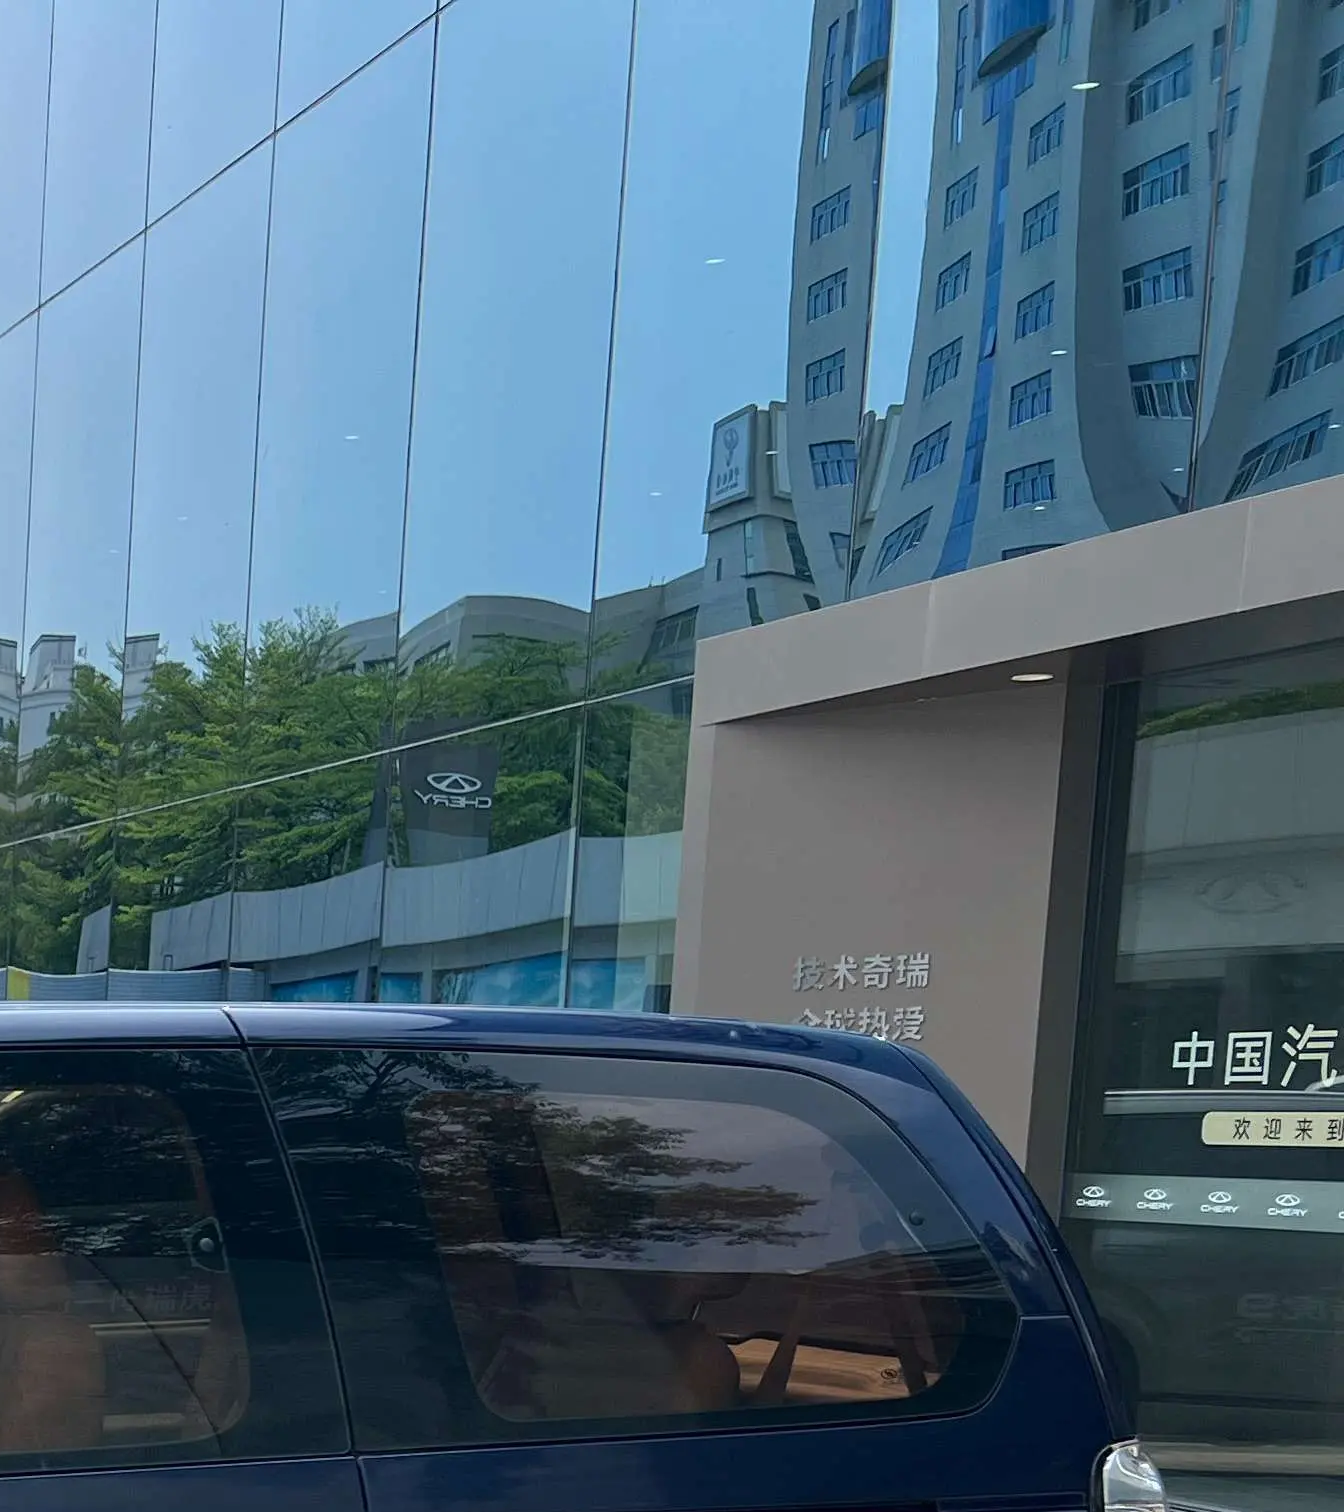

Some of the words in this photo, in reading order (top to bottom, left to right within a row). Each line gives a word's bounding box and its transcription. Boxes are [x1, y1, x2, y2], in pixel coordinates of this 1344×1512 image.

[791, 952, 931, 992] 技术奇瑞
[1171, 1023, 1340, 1088] 中国汽
[1231, 1116, 1344, 1142] 欢迎来到
[1076, 1198, 1113, 1208] CHERY
[1136, 1201, 1175, 1211] CHERY
[1200, 1203, 1240, 1214] CHERY
[1267, 1207, 1309, 1217] CHERY
